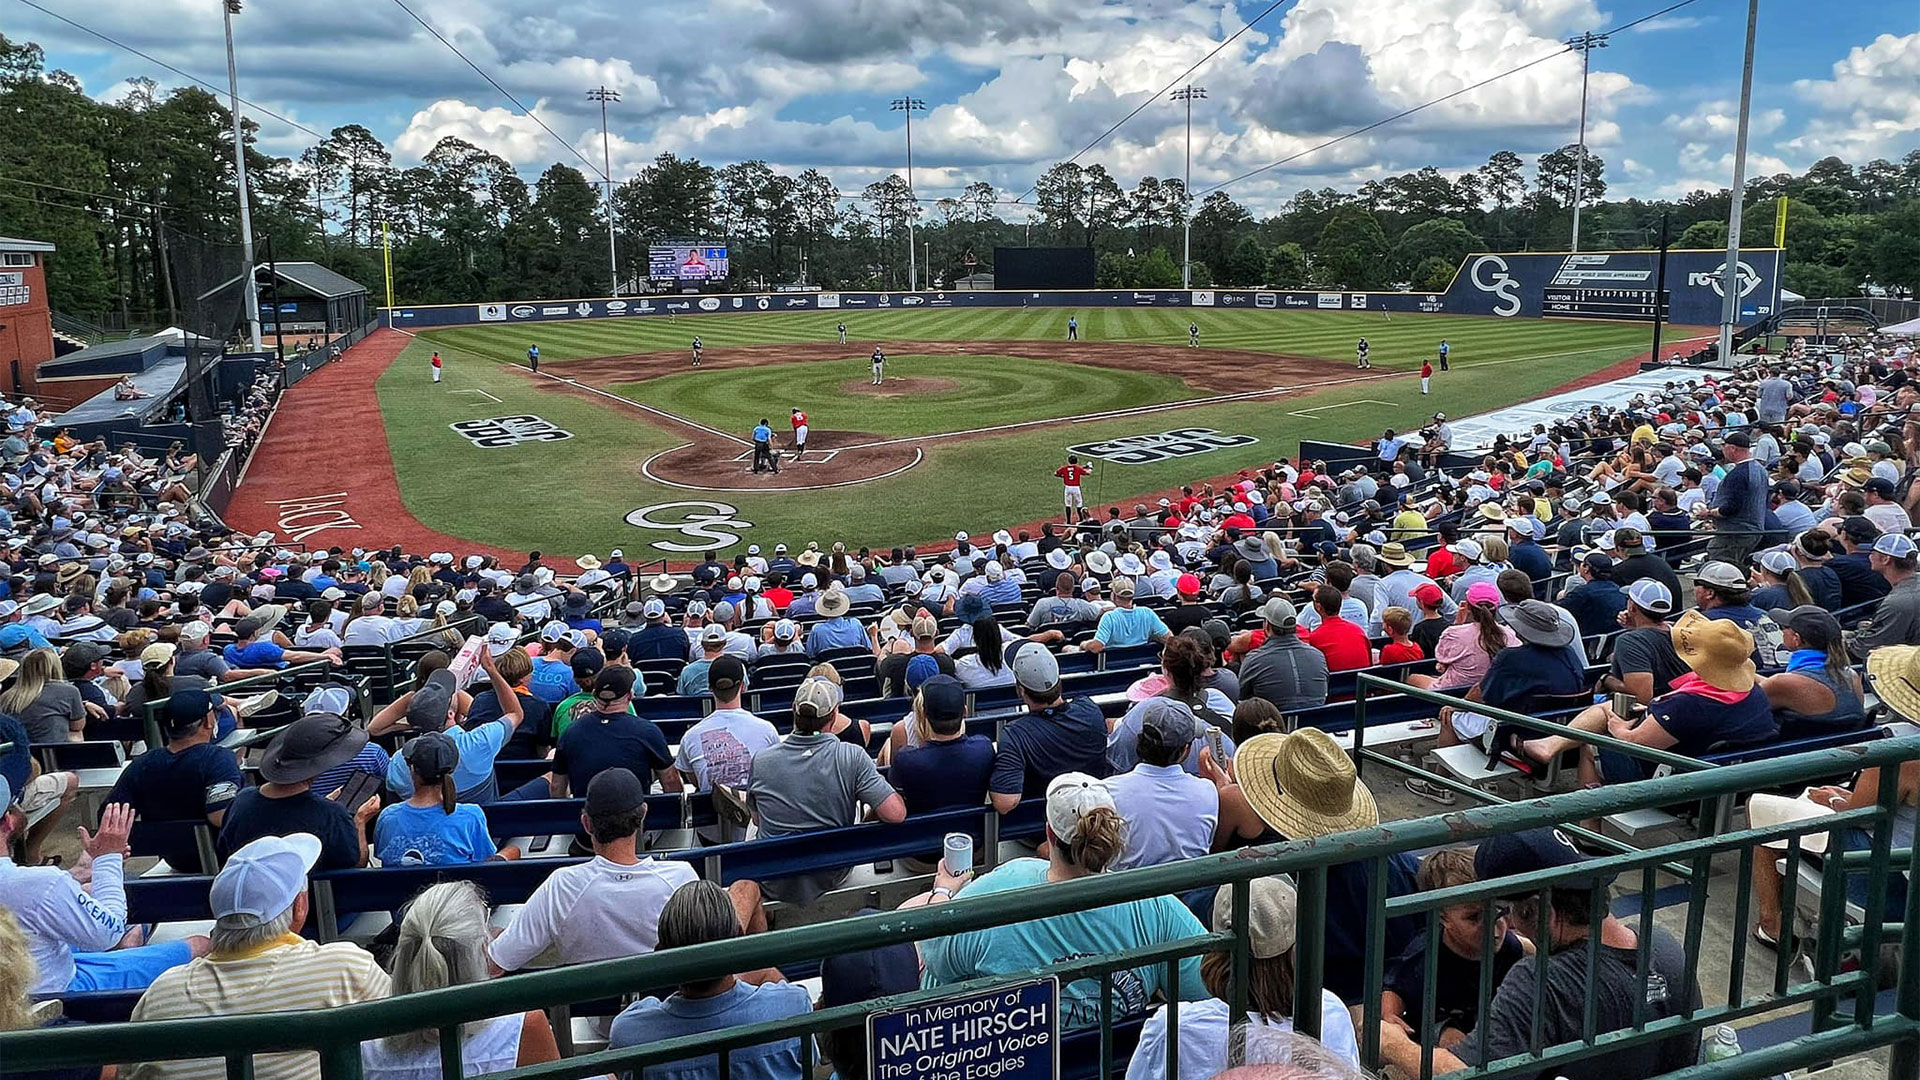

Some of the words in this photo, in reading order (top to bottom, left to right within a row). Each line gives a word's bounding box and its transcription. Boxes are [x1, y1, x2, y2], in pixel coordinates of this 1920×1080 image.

[1068, 471, 1074, 480] 5
[905, 1012, 921, 1027] In
[925, 997, 1000, 1024] Memory
[1004, 989, 1023, 1007] of
[880, 1026, 944, 1060] NATE
[952, 1003, 1047, 1045] HIRSCH
[879, 1062, 912, 1080] The
[915, 1041, 992, 1073] Original
[997, 1031, 1050, 1052] Voice
[966, 1054, 1026, 1079] Eagles
